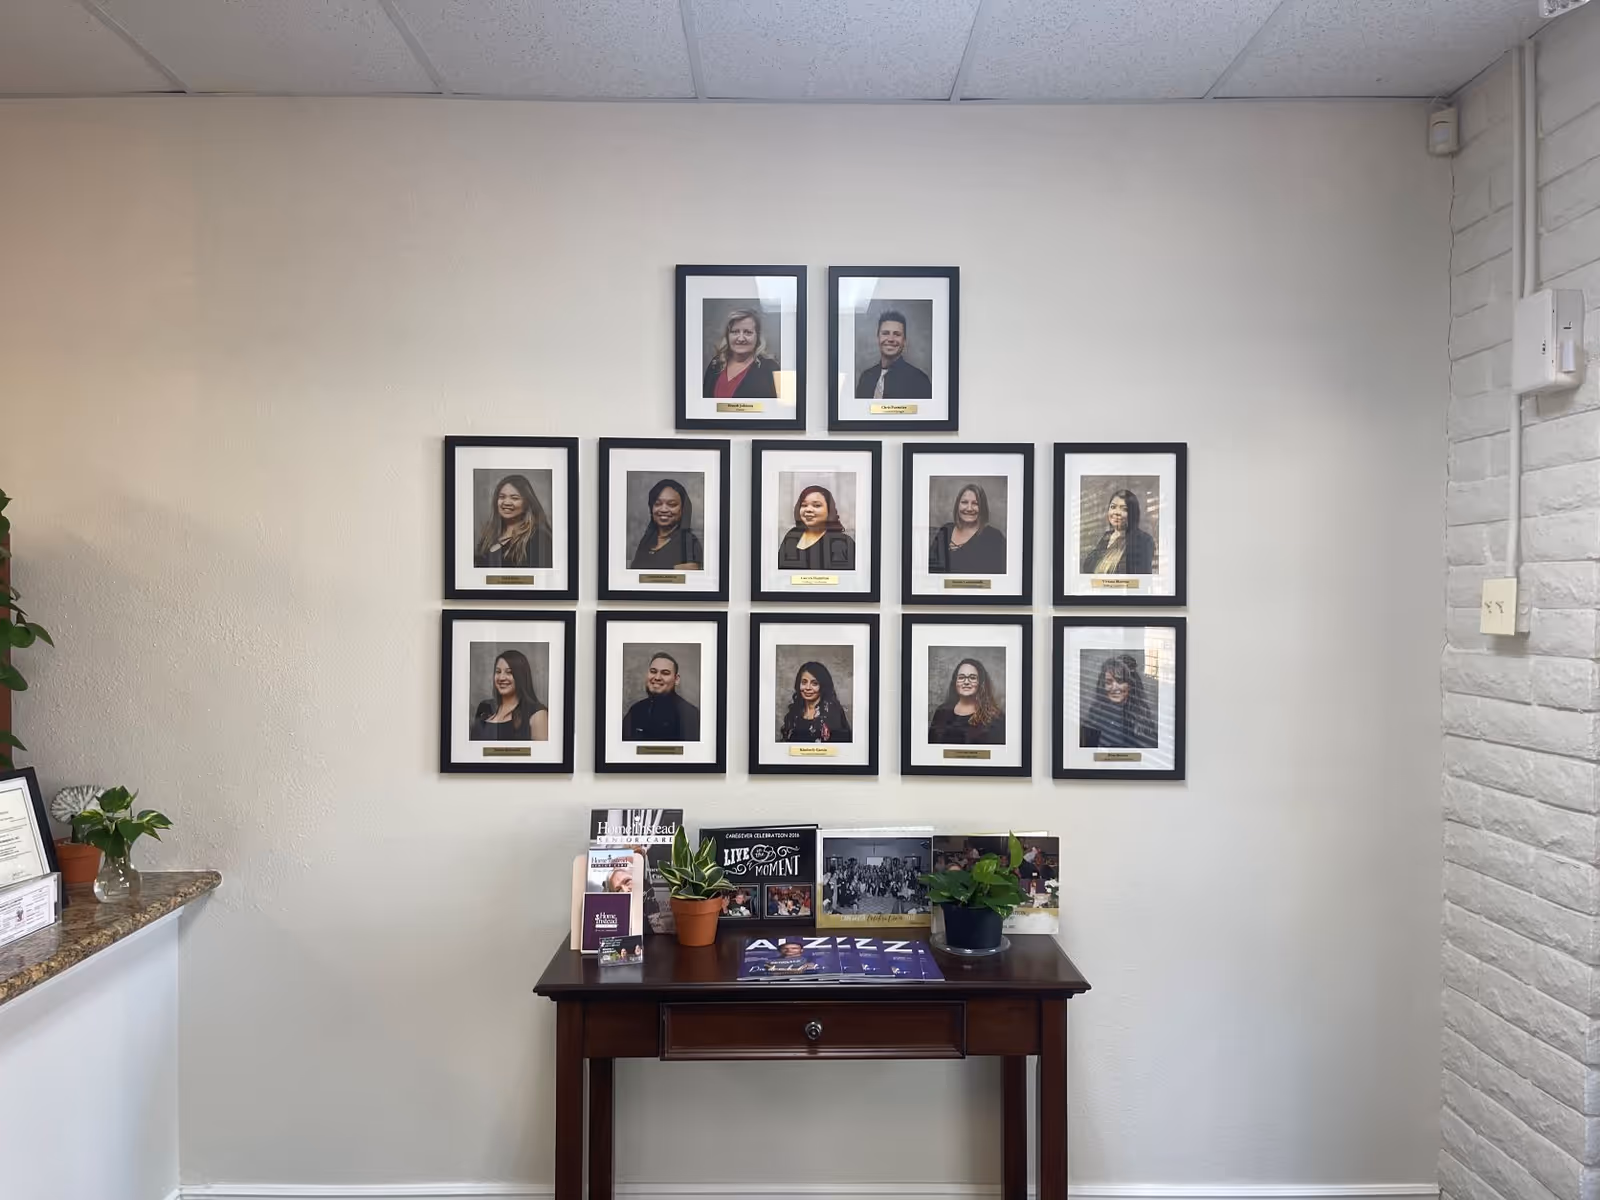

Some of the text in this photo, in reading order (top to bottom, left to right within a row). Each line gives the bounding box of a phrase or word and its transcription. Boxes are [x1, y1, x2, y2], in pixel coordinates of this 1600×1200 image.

[597, 821, 676, 835] Home Instead
[723, 847, 750, 867] LIVE
[755, 854, 801, 877] MOMENT
